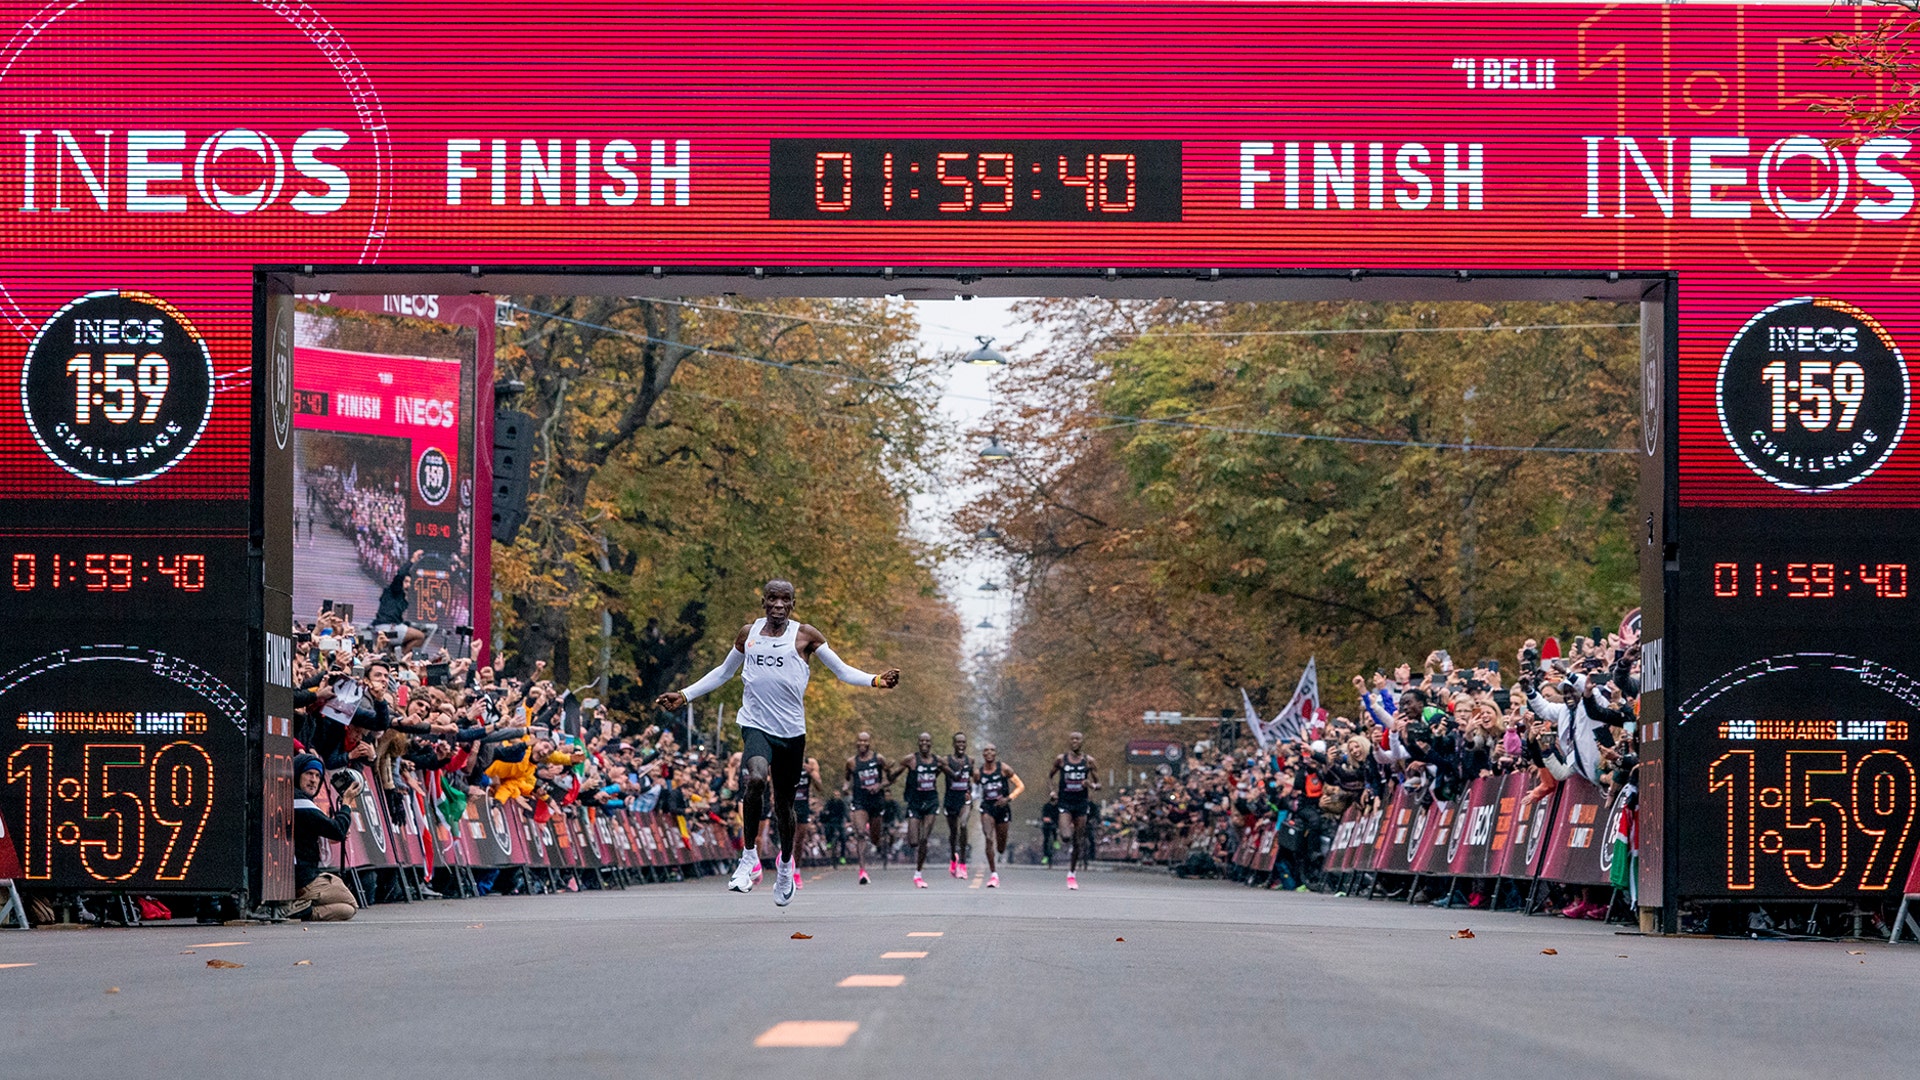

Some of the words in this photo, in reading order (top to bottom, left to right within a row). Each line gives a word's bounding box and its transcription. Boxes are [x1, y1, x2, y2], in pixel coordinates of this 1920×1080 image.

[18, 128, 352, 215] INEOS
[446, 139, 691, 206] FINISH
[815, 152, 1136, 212] 01:59:40
[1239, 142, 1484, 211] FINISH
[1581, 135, 1915, 222] INEOS
[74, 318, 164, 344] INEOS
[1768, 326, 1858, 352] INEOS
[66, 353, 170, 424] 1:59
[336, 393, 381, 420] FINISH
[395, 395, 455, 428] INEOS
[1761, 360, 1865, 432] 1:59
[55, 420, 182, 464] CHALLENGE
[1750, 429, 1878, 473] CHALLENGE
[12, 553, 205, 591] 01:59:40
[1714, 563, 1908, 598] 01:59:40
[266, 632, 292, 688] FINISH
[16, 711, 208, 735] #NOHUMANISLIMITED
[1717, 719, 1909, 741] #NOHUMANISLIMITED
[7, 741, 214, 882] 1:59
[1708, 749, 1917, 890] 1:59
